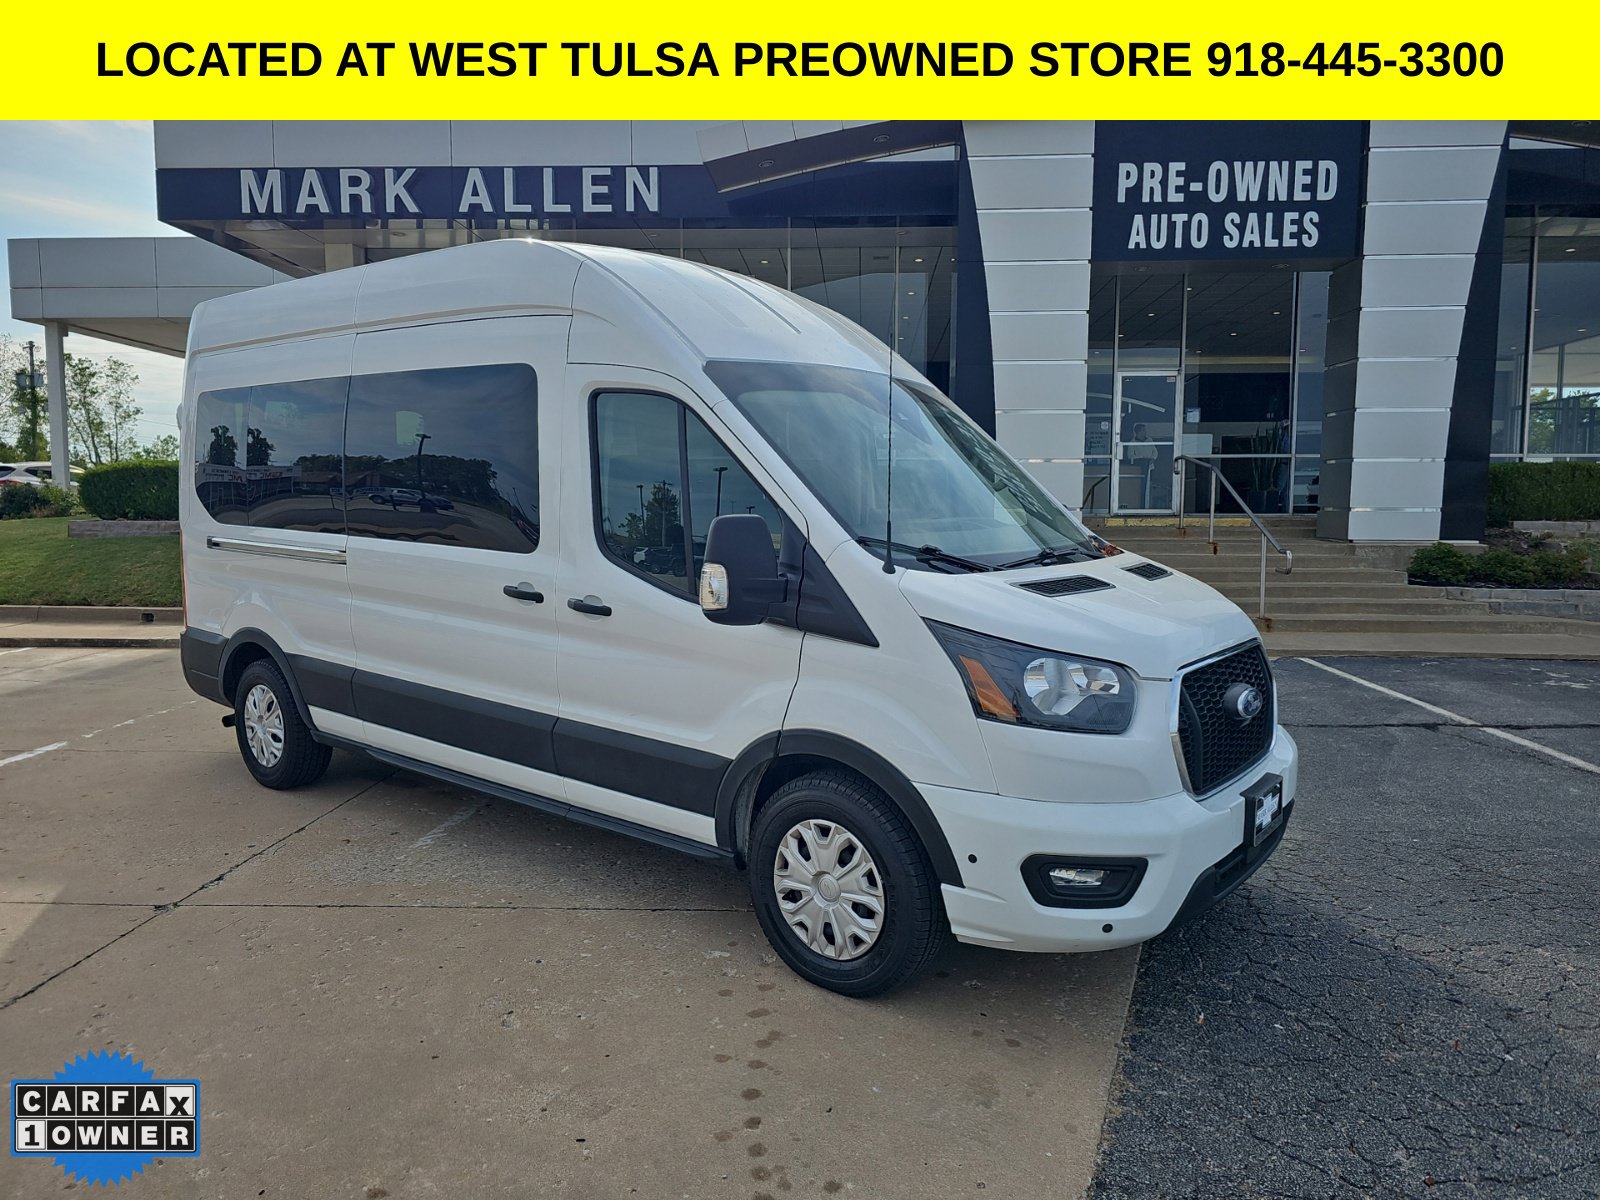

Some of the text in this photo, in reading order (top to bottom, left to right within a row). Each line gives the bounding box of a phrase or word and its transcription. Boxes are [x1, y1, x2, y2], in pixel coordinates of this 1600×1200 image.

[240, 166, 660, 214] MARK ALLEN
[1116, 159, 1339, 204] PRE-OWNED
[1127, 210, 1320, 250] AUTO SALES
